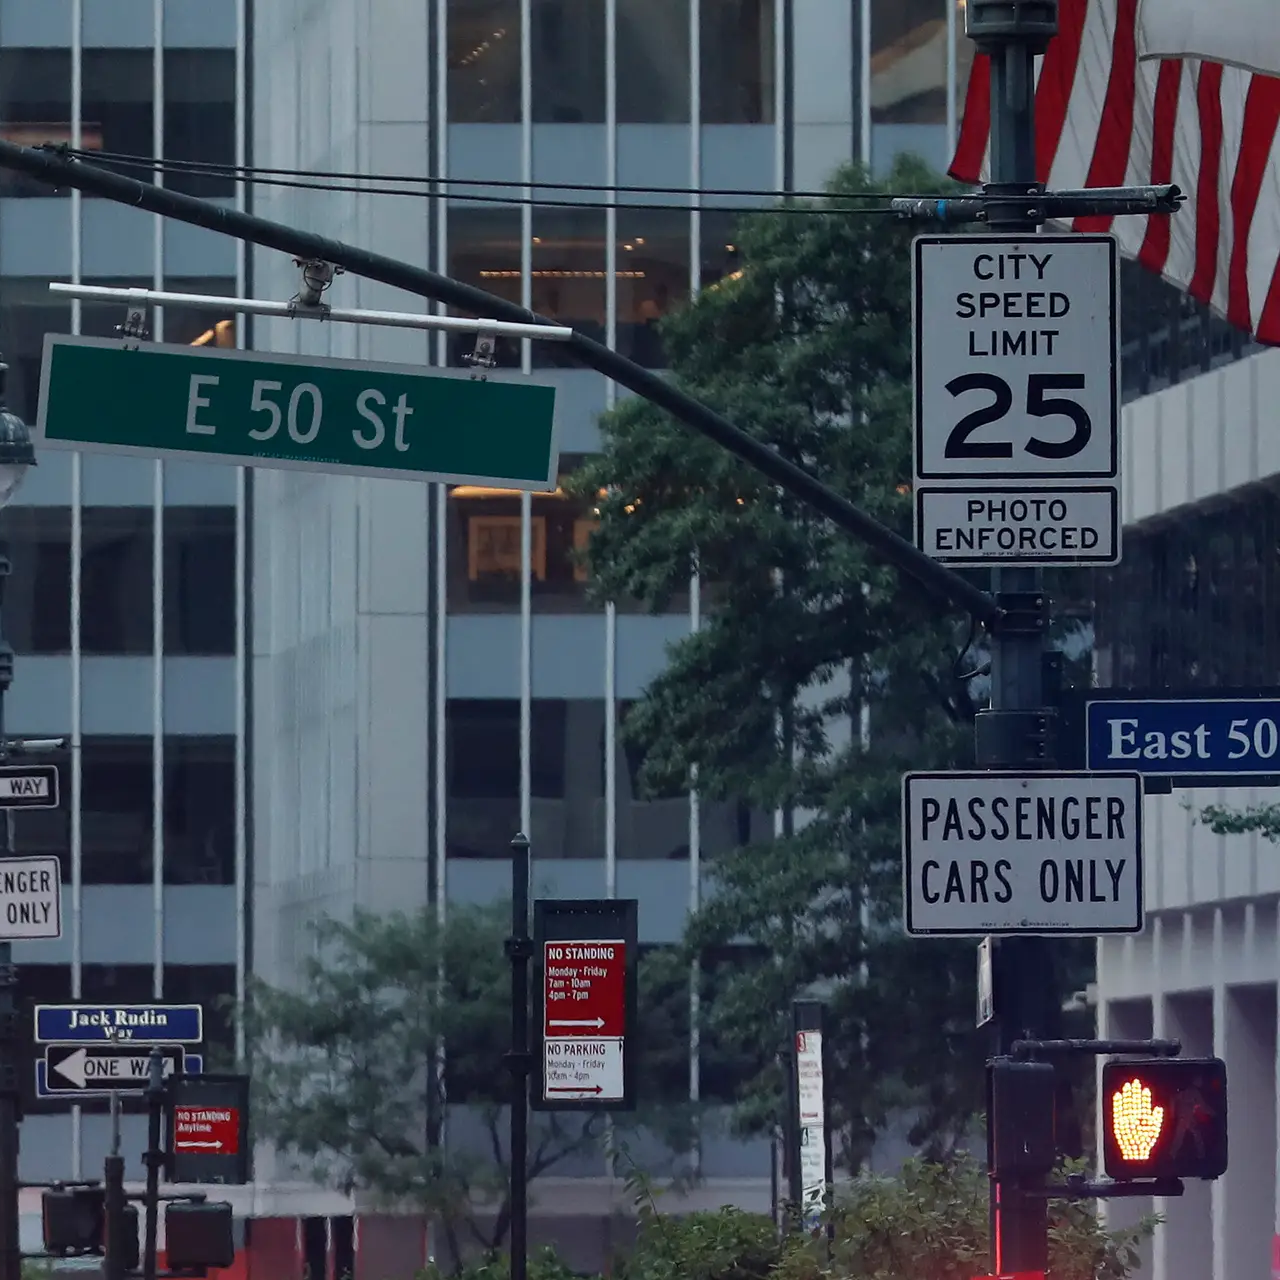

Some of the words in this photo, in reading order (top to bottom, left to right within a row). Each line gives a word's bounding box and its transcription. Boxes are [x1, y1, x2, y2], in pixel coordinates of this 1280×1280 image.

[973, 254, 1053, 280] CITY
[955, 292, 1070, 318] SPEED
[969, 330, 1059, 356] LIMIT
[185, 374, 220, 435] E
[247, 379, 323, 444] 50
[352, 388, 414, 452] St
[944, 372, 1092, 459] 25
[967, 499, 1067, 522] PHOTO
[936, 527, 1099, 550] ENFORCED
[1106, 718, 1212, 759] East
[1227, 718, 1279, 759] 50
[10, 779, 43, 794] WAY
[921, 797, 1125, 841] PASSENGER
[921, 859, 1013, 904] CARS
[1040, 859, 1126, 903] ONLY
[7, 901, 51, 924] ONLY
[548, 948, 563, 960] NO
[565, 947, 615, 960] STANDING
[548, 966, 578, 979] Monday
[583, 966, 608, 978] Friday
[548, 978, 565, 988] 7am
[571, 978, 591, 988] 10am
[548, 990, 566, 1001] 4pm
[572, 990, 589, 1001] 7pm
[68, 1010, 111, 1029] Jack
[114, 1009, 168, 1026] Rudin
[103, 1026, 133, 1040] Way
[547, 1044, 561, 1056] NO
[564, 1044, 606, 1056] PARKING
[83, 1060, 120, 1077] ONE
[547, 1059, 576, 1070] Monday
[582, 1059, 605, 1070] Friday
[574, 1070, 590, 1081] 4pm
[178, 1112, 190, 1121] NO
[191, 1111, 231, 1122] STANDING
[177, 1122, 212, 1133] Anytime
